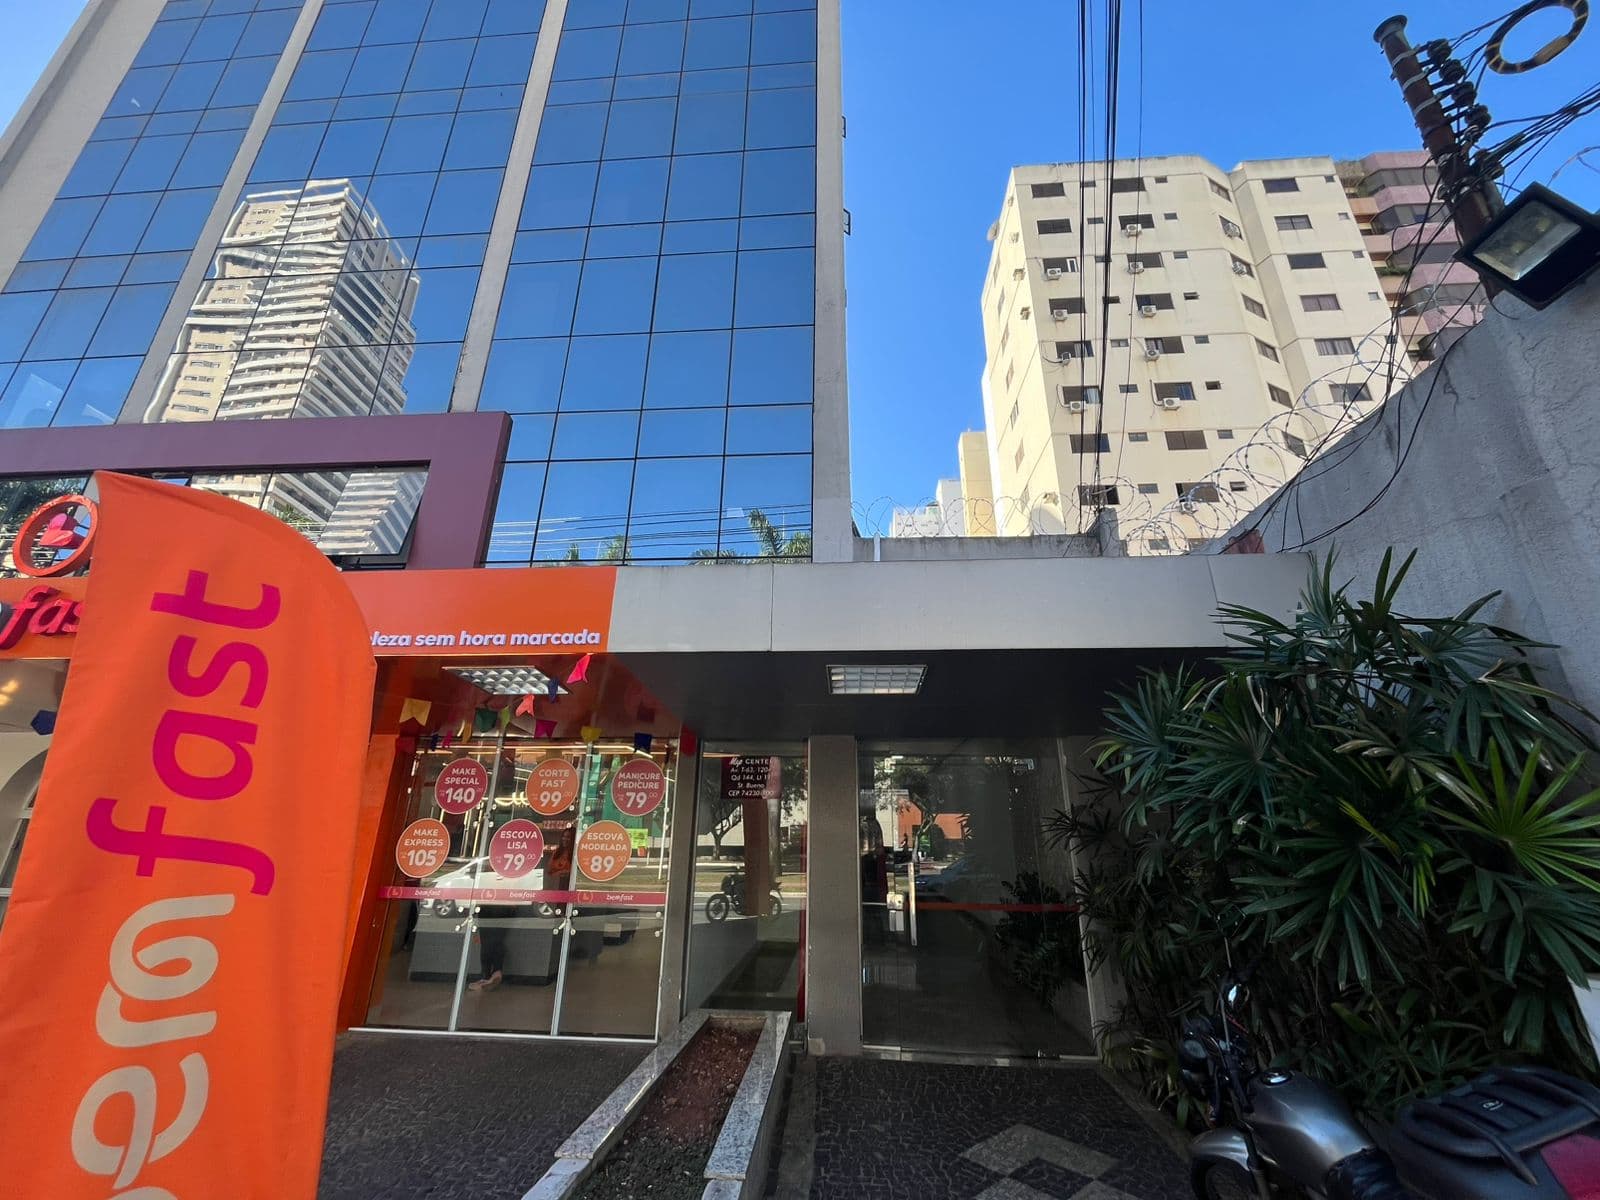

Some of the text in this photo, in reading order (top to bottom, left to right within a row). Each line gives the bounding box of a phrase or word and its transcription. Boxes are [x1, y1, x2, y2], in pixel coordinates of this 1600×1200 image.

[371, 628, 600, 647] leza sem hora marcada
[538, 769, 570, 777] CORTE
[618, 772, 661, 780] MANICURE
[444, 777, 480, 785] SPECIAL
[541, 779, 566, 788] FAST
[618, 781, 659, 789] PEDICURE
[445, 787, 476, 803] 140
[540, 790, 562, 807] 99
[626, 792, 647, 808] 79
[413, 828, 438, 836] MAKE
[500, 830, 538, 839] ESCOVA
[587, 832, 624, 841] ESCOVA
[404, 838, 444, 846] EXPRESS
[507, 841, 528, 849] LISA
[581, 843, 627, 851] MODELADA
[407, 849, 437, 866] 105
[503, 853, 525, 870] 79
[590, 855, 614, 873] 89
